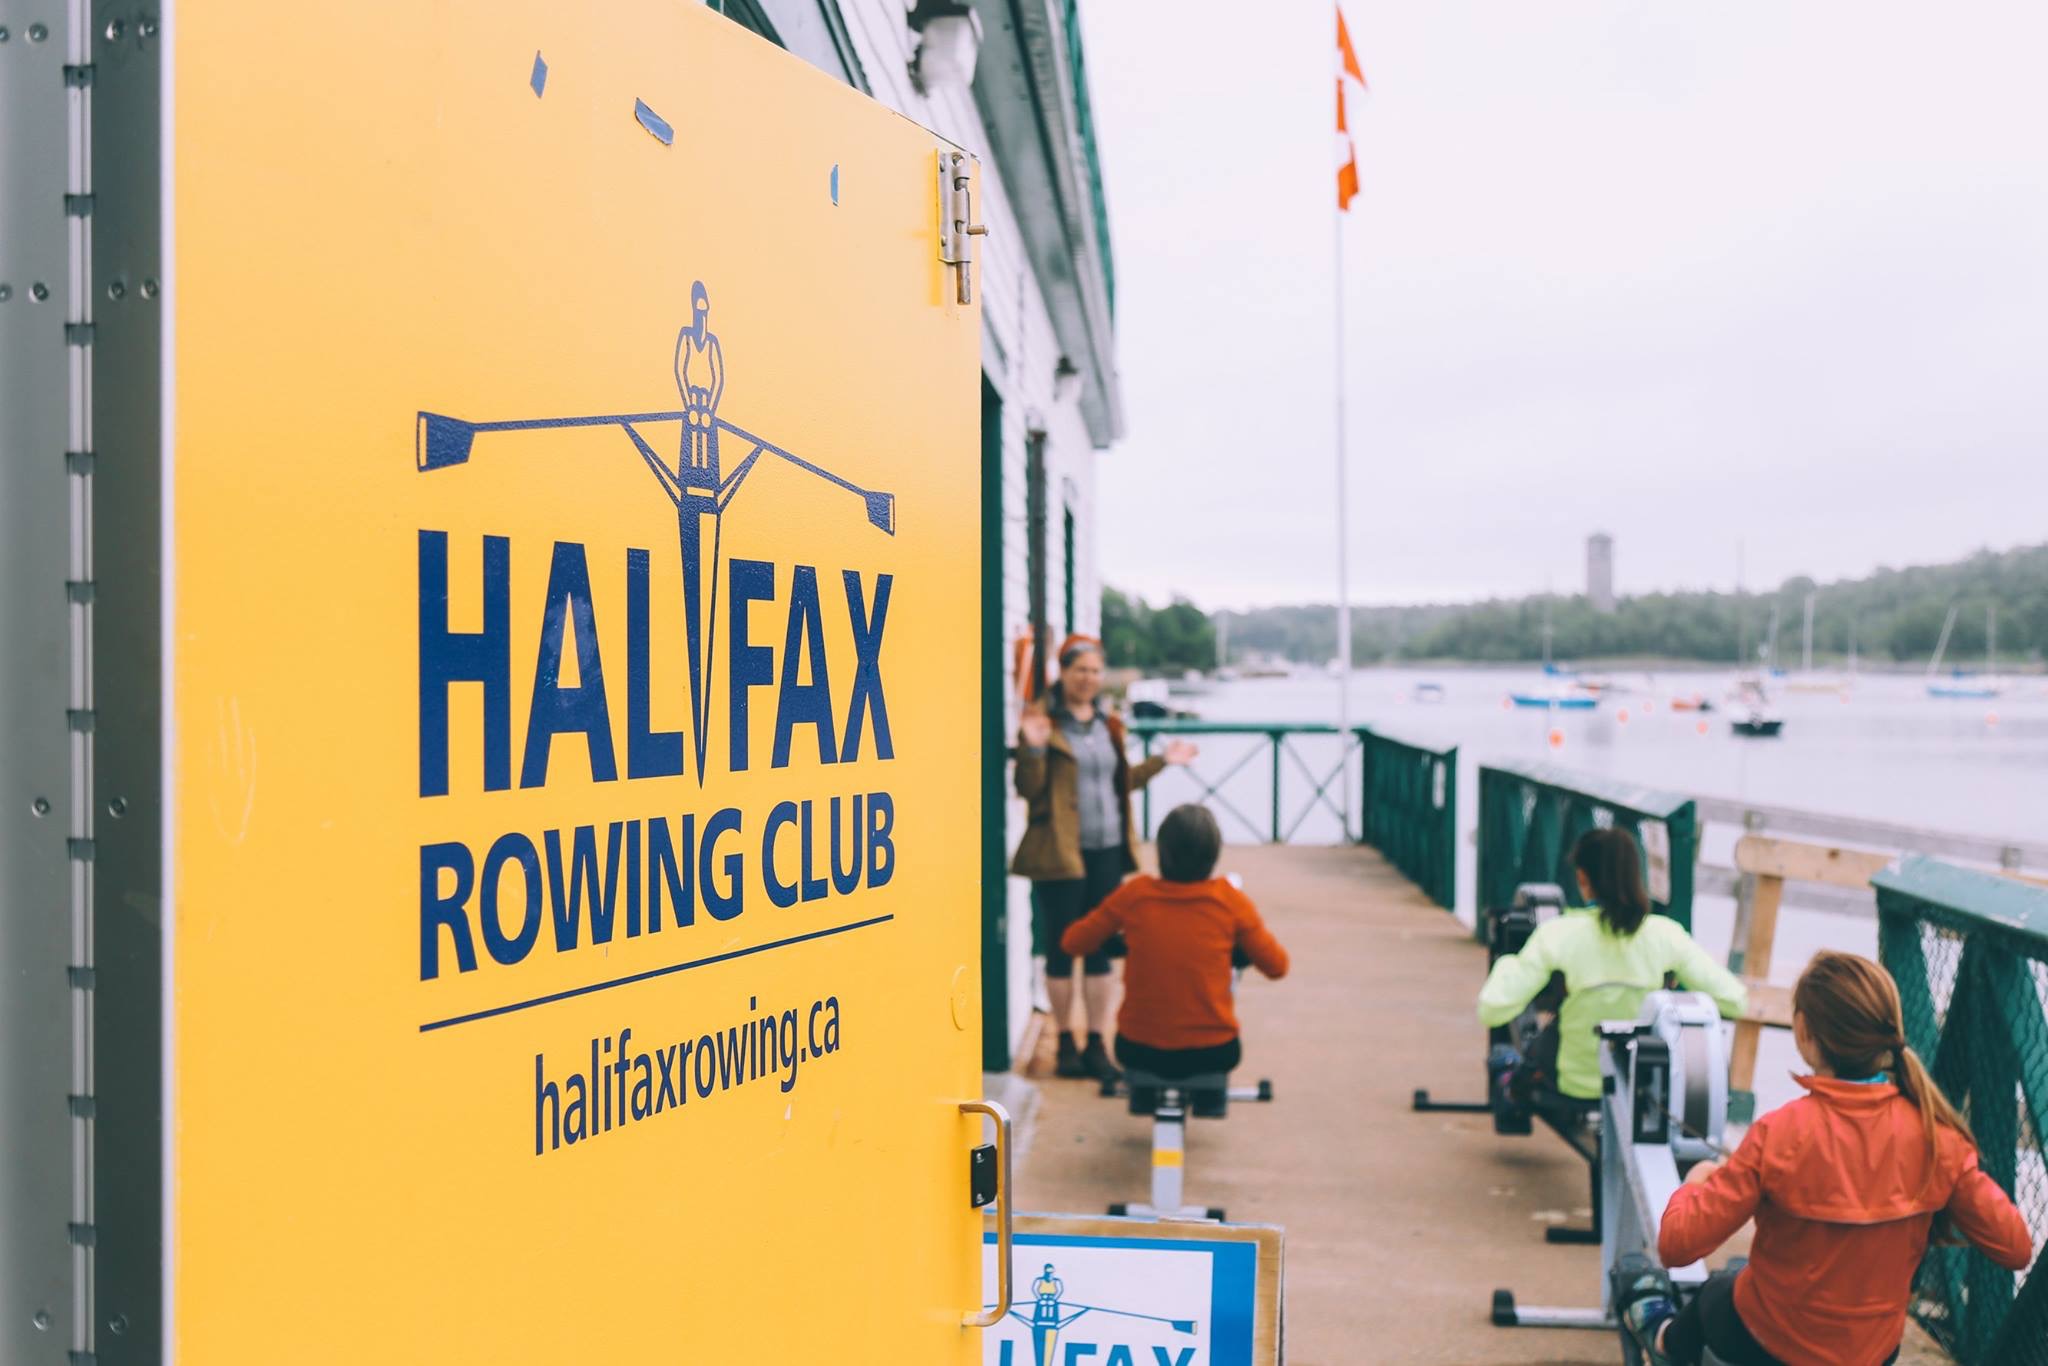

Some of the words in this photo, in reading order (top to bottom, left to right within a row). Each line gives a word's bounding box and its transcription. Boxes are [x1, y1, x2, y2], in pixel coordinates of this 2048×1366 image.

[418, 529, 895, 798] HALIFAX
[419, 807, 744, 982] ROWING
[761, 791, 895, 909] CLUB
[535, 995, 841, 1156] halifaxrowing.ca
